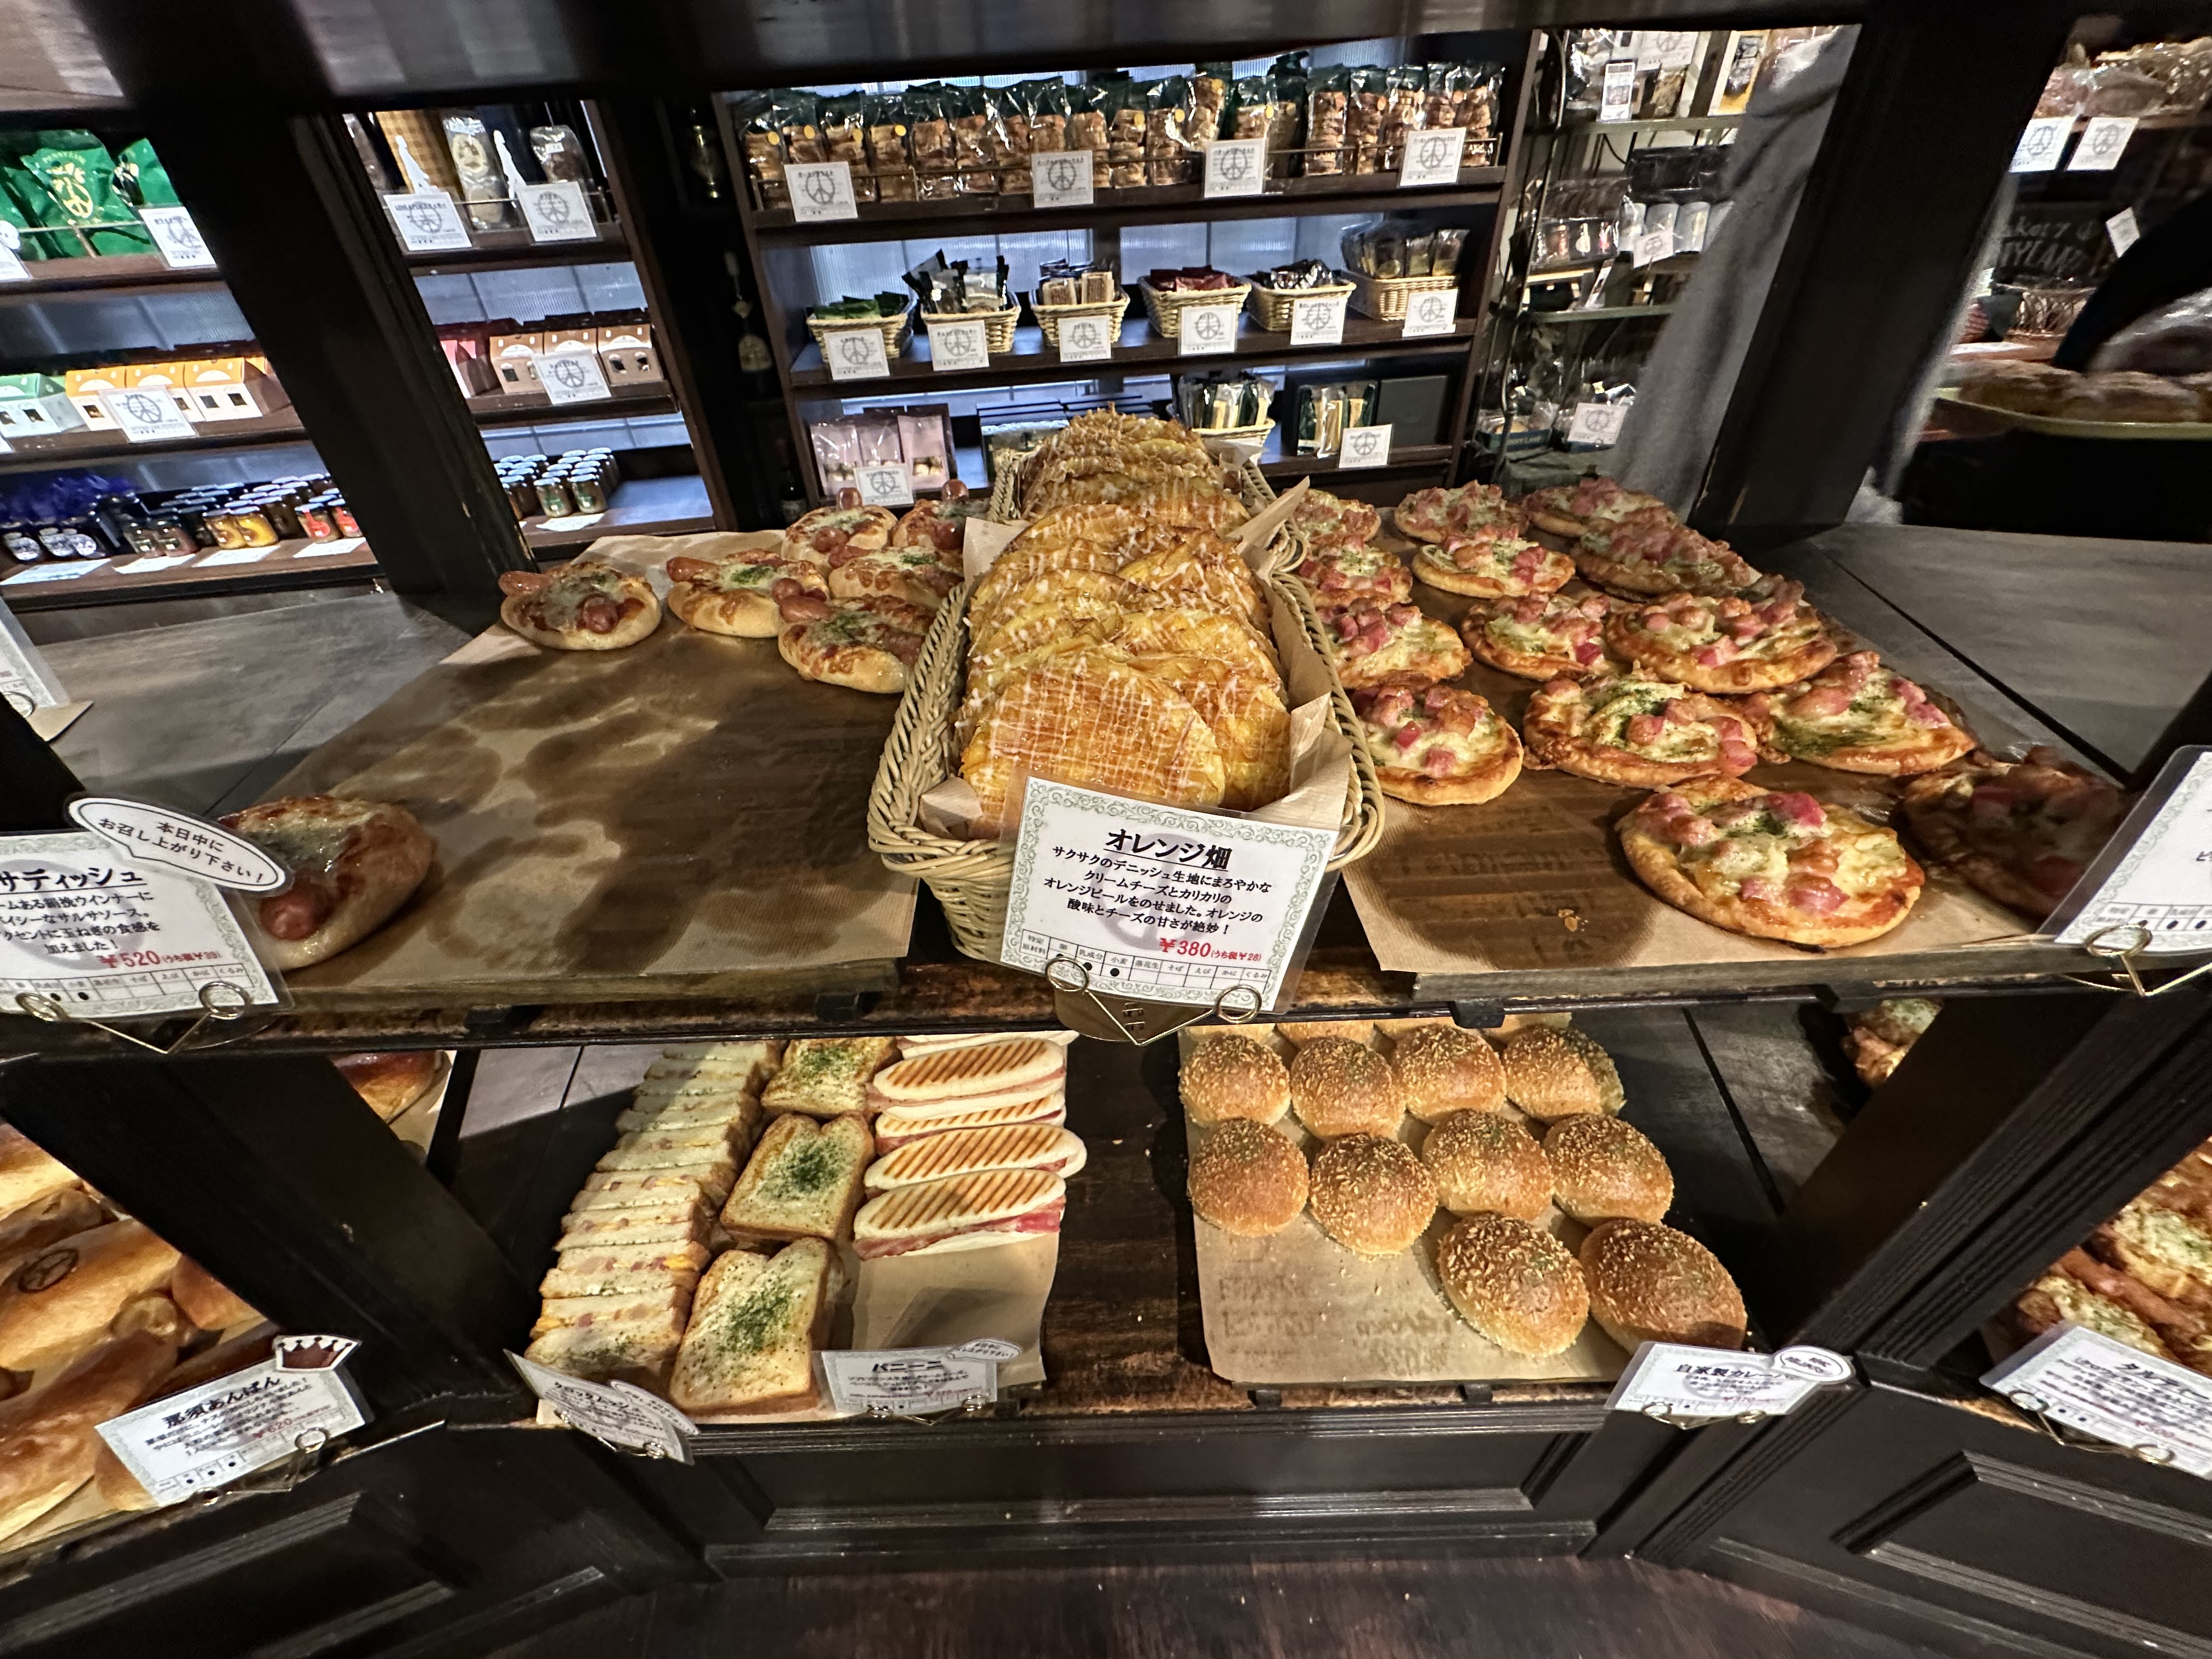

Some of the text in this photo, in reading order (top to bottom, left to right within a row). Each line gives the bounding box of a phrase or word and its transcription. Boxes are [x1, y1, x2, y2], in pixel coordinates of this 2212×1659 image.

[157, 822, 224, 852] 本日中に
[1105, 829, 1233, 870] オレンジ畑
[1052, 847, 1272, 893] サクサクのデニッシュ生地にまろやかな
[1084, 870, 1232, 904] クリームチーズとカリカリの
[1044, 877, 1263, 923] オレンジピールをのせました。オレンジの
[2114, 1363, 2212, 1403] タルティー
